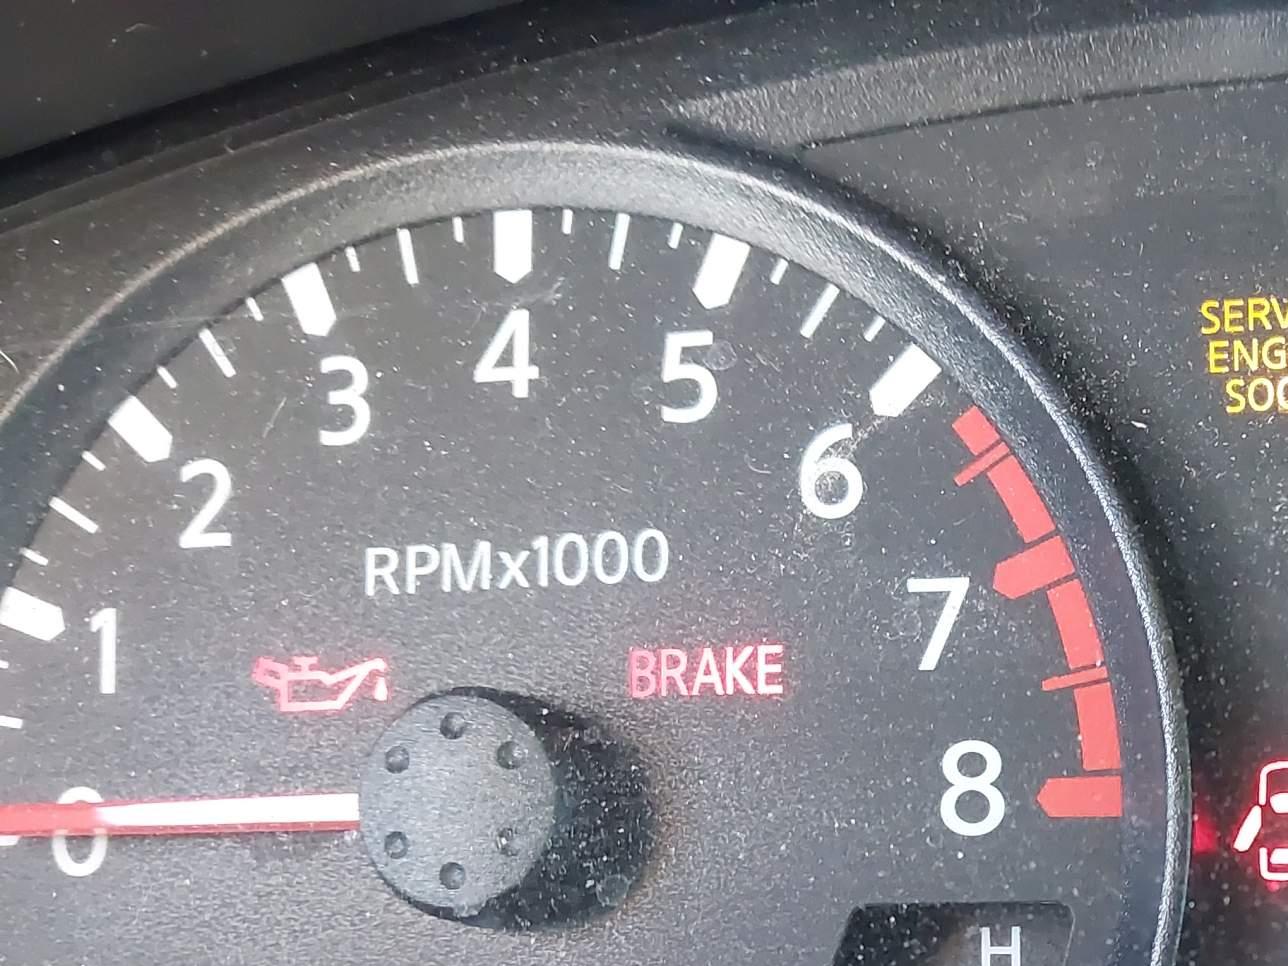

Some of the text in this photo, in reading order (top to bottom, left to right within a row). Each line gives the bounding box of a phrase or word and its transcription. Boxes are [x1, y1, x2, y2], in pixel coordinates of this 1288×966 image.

[473, 308, 540, 399] 4
[660, 329, 719, 424] 5
[318, 355, 371, 446] 3
[178, 458, 234, 549] 2
[798, 422, 864, 520] 6
[364, 529, 670, 598] RPMx1000
[90, 607, 117, 694] 1
[906, 576, 970, 671] 7
[630, 644, 784, 698] BRAKE
[939, 739, 1006, 836] 8
